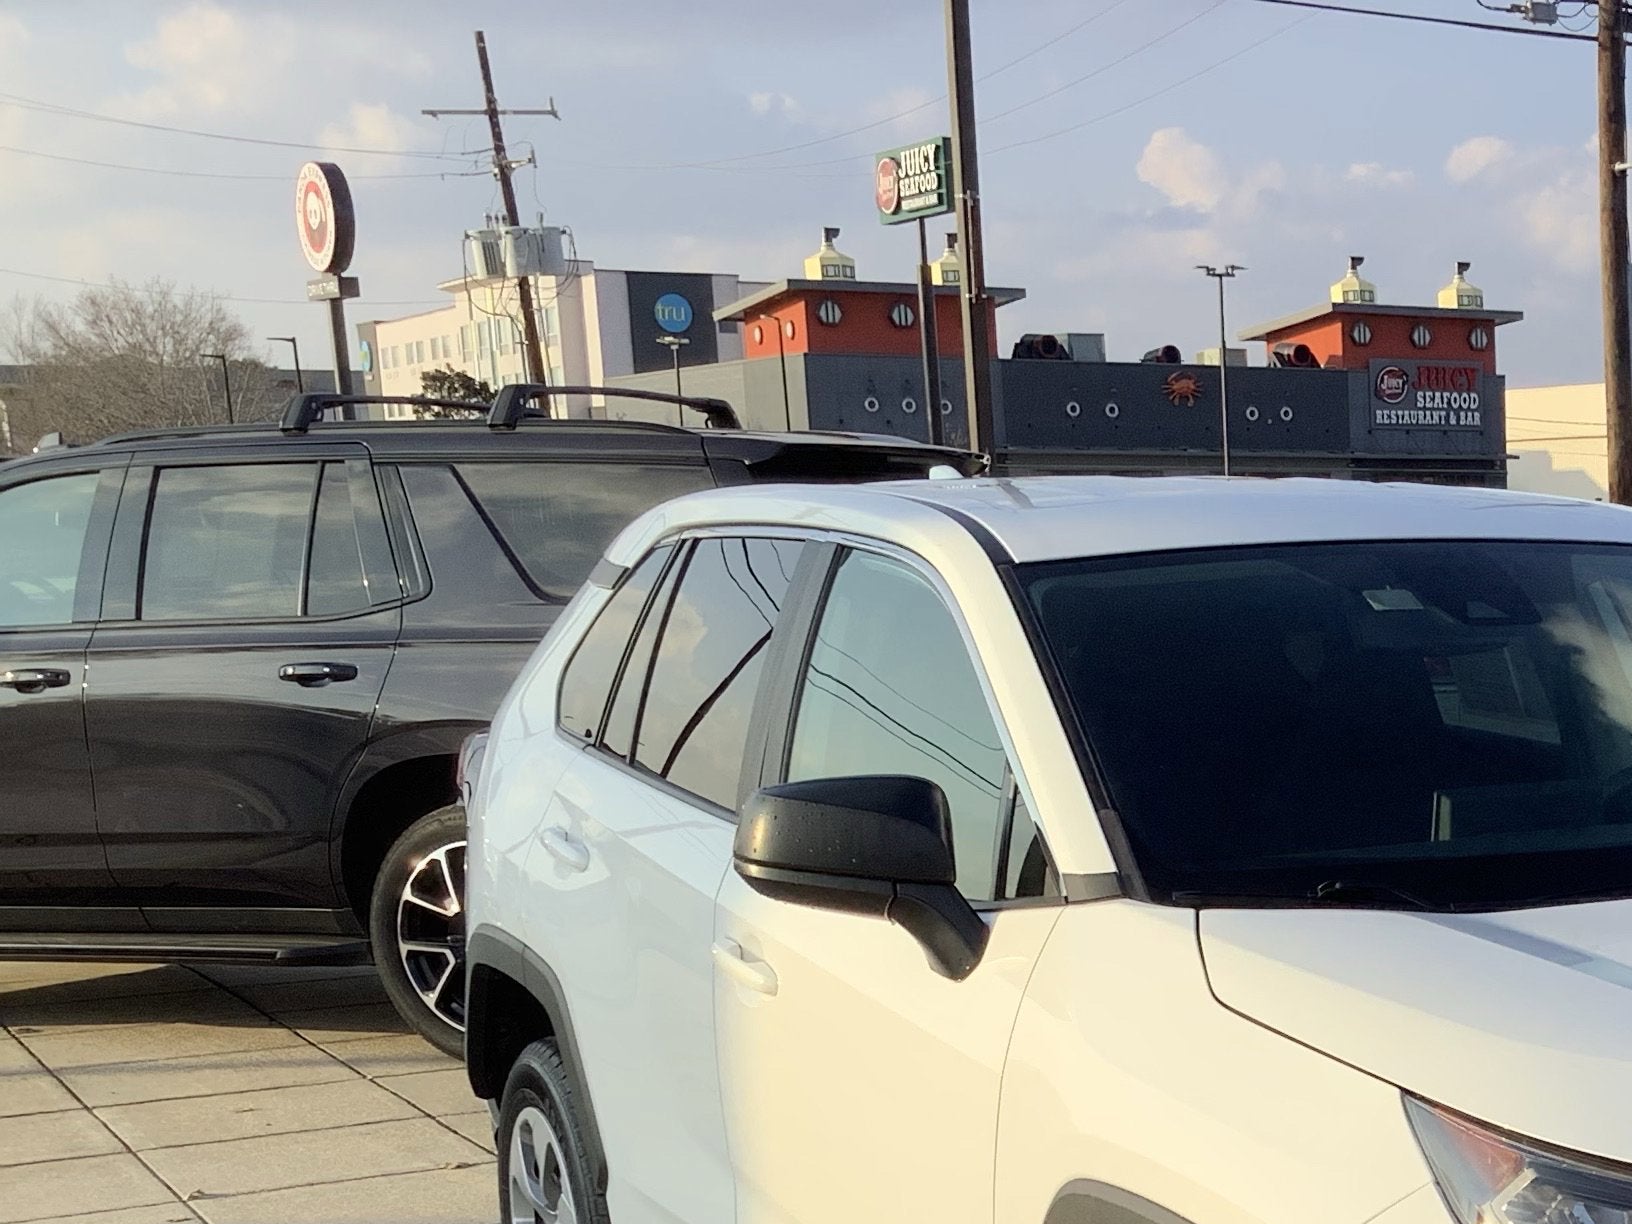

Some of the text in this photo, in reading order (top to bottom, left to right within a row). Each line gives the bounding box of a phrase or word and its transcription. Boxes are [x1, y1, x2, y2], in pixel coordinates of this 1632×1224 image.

[898, 144, 936, 179] JUICY
[899, 171, 938, 198] SEAFOOD
[1411, 365, 1478, 392] JUICY
[1416, 391, 1480, 410] SEAFOOD
[1375, 409, 1481, 426] RESTAURANT & BAR
